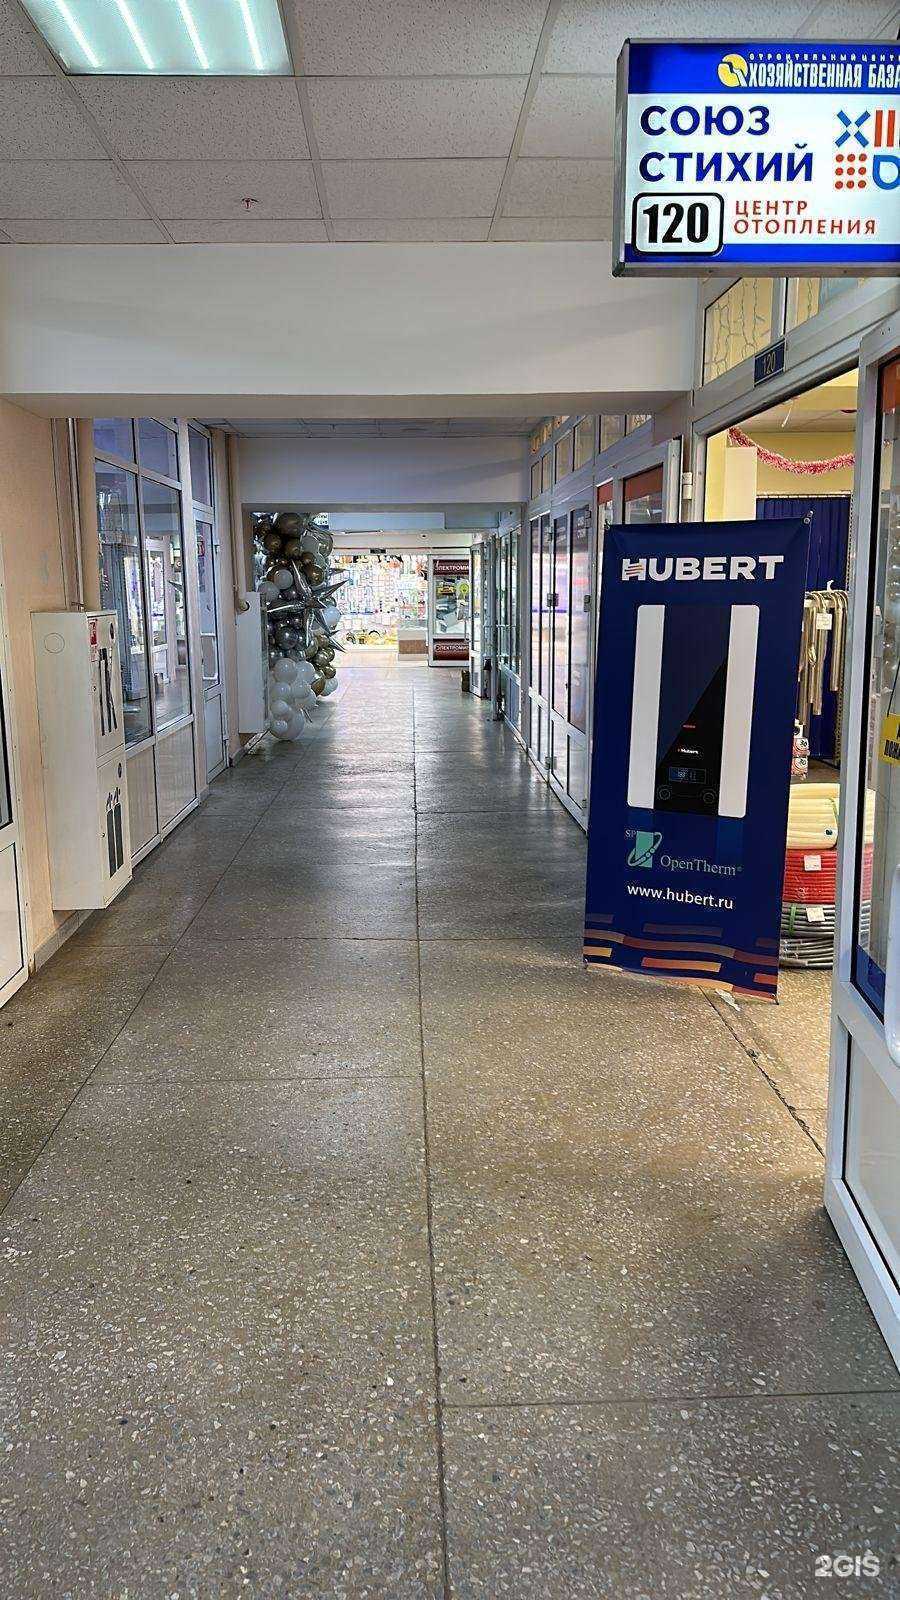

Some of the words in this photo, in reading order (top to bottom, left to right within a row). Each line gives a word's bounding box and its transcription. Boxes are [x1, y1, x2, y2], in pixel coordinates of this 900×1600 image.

[861, 54, 900, 62] ЦЕНТ
[748, 59, 862, 88] ХОЗЯЙСТВЕННАЯ
[640, 105, 770, 136] СОЮЗ
[638, 143, 814, 183] СТИХИЙ
[735, 200, 808, 217] ЦЕНТР
[643, 202, 709, 244] 120
[734, 218, 877, 235] ОТОПЛЕНИЯ
[763, 351, 776, 376] 120
[621, 555, 785, 582] HUBERT
[627, 884, 734, 910] www.hubert.ru
